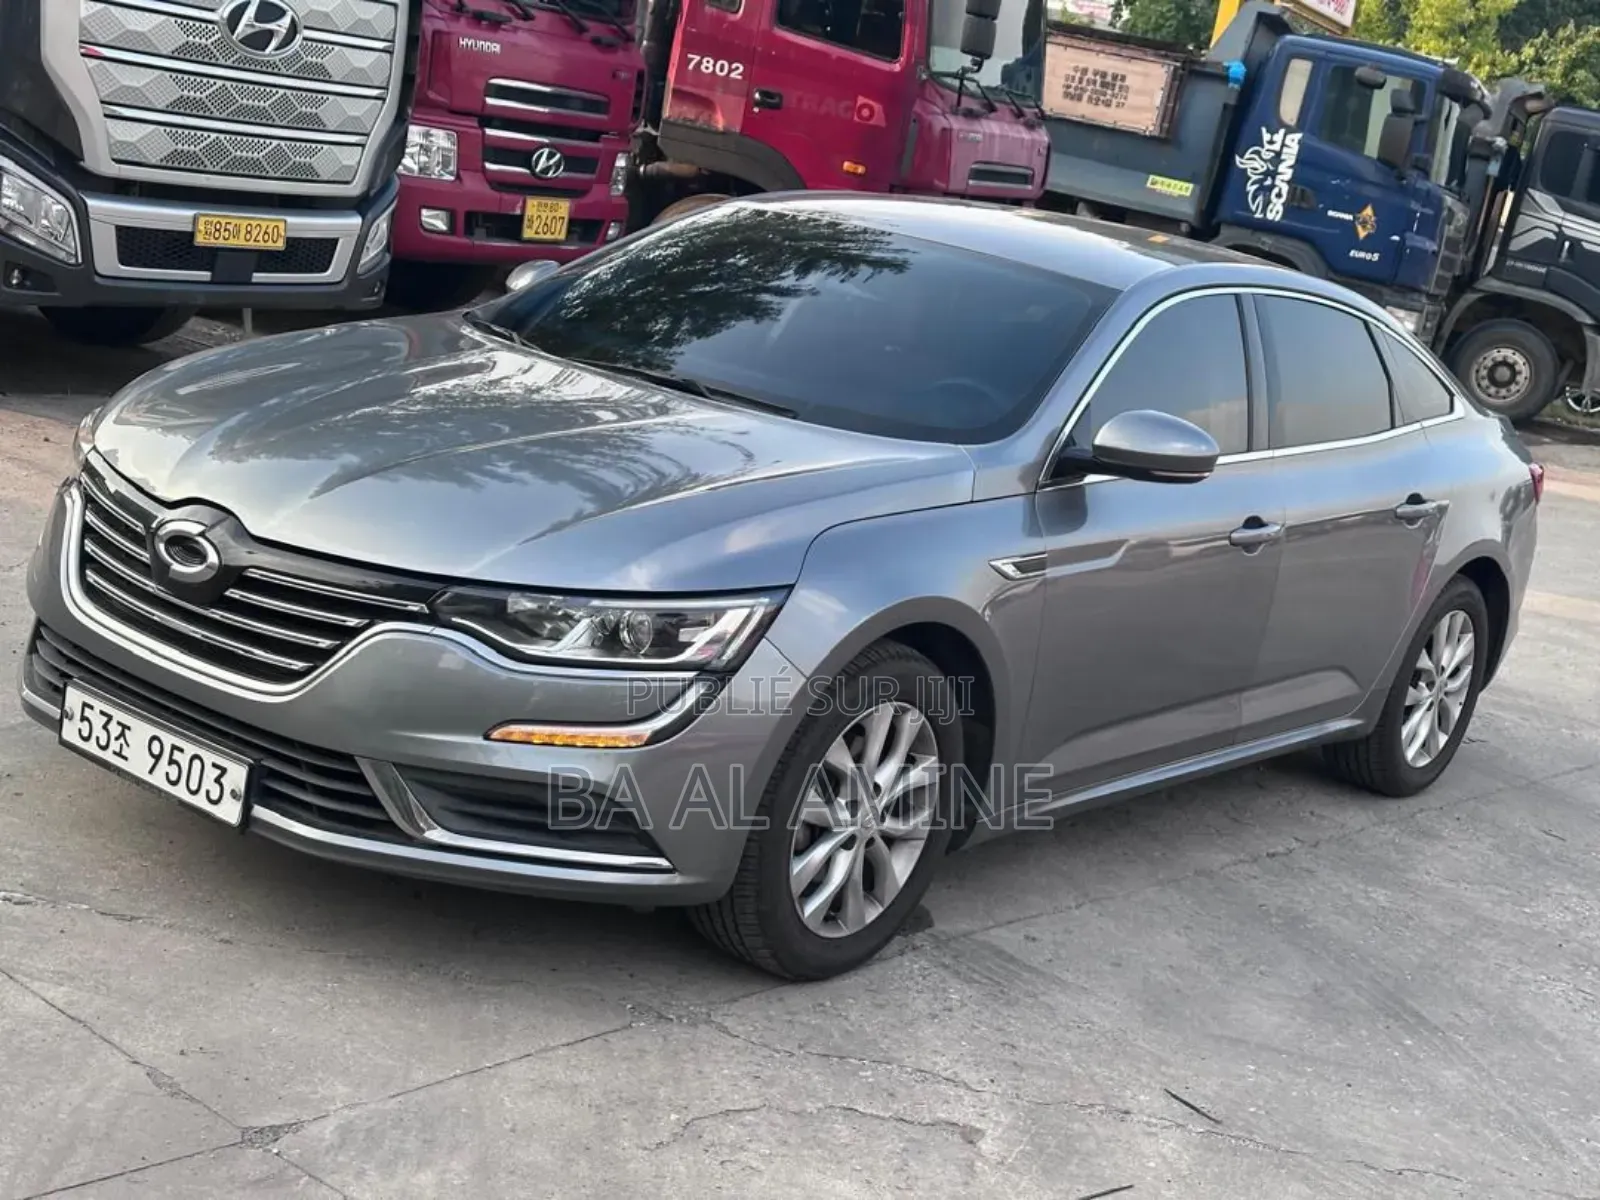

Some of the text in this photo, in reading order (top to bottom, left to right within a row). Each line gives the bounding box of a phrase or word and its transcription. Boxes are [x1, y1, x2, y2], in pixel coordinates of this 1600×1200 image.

[458, 37, 500, 54] HYUNDAI
[687, 54, 744, 80] 7802
[1266, 132, 1303, 221] SCANIA
[244, 223, 280, 244] 8260
[78, 701, 228, 806] 53조 9503
